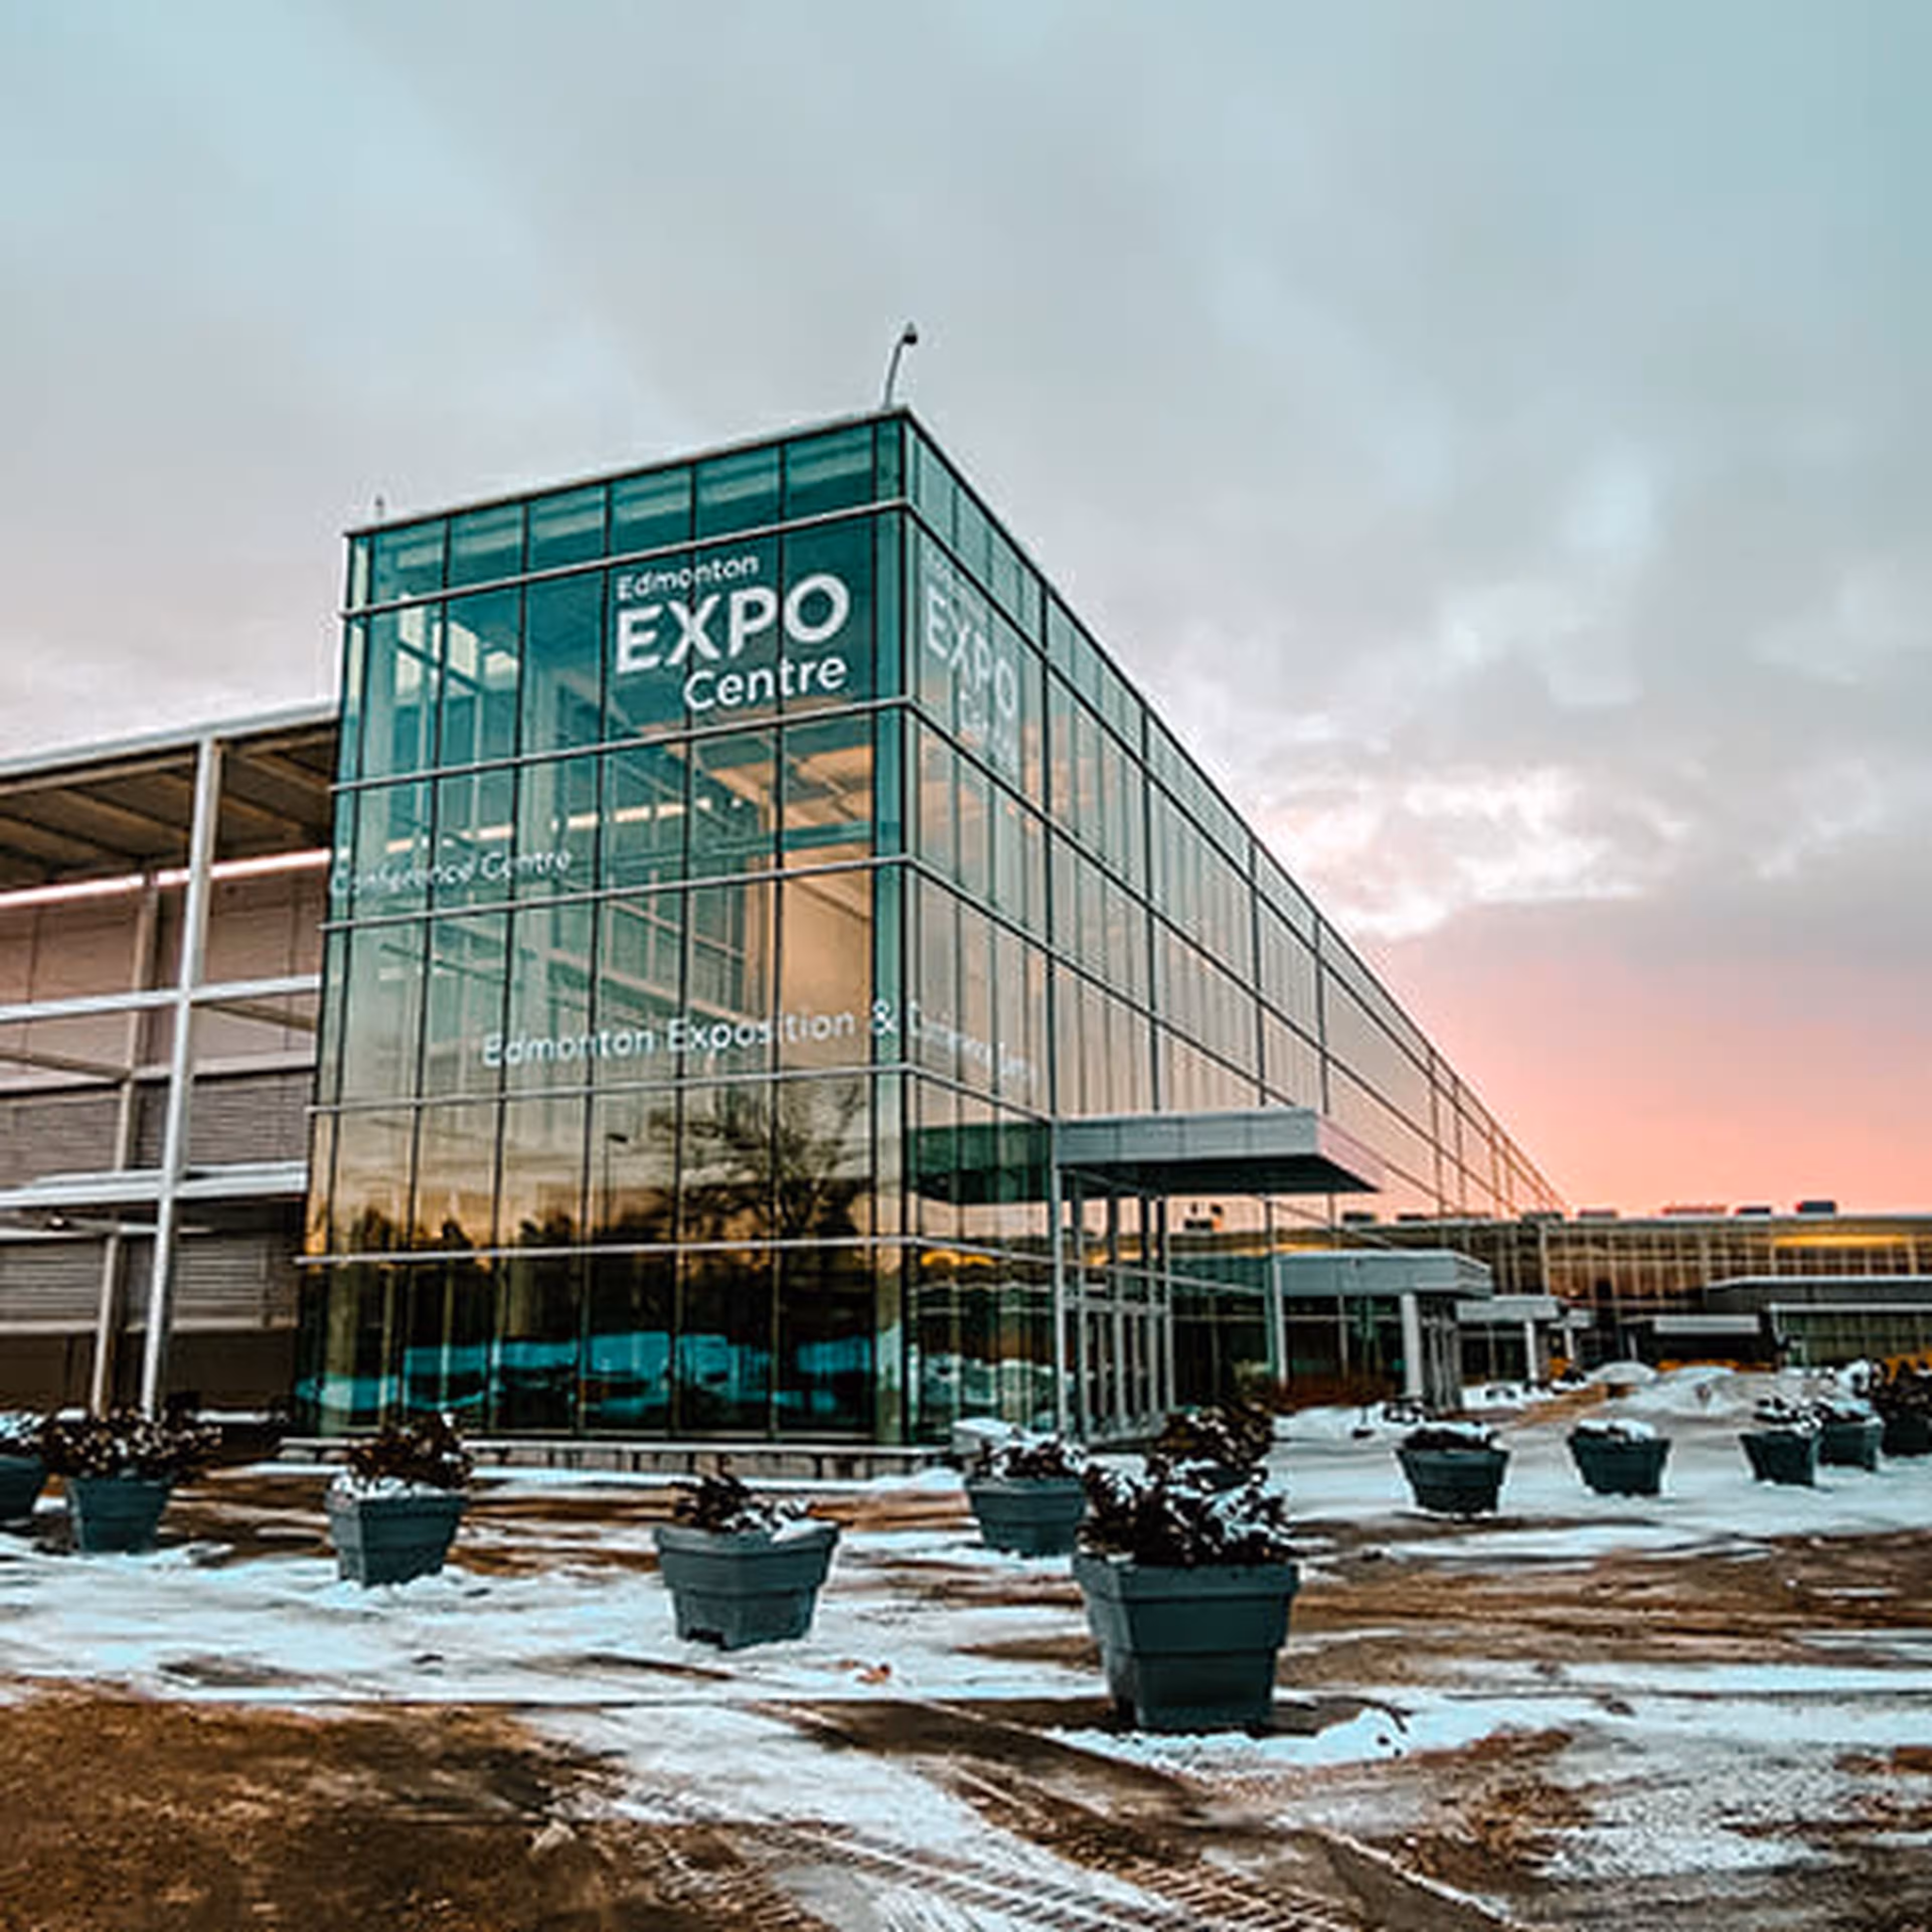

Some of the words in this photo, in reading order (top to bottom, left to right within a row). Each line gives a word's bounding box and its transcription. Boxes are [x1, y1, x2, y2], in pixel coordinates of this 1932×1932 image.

[617, 555, 758, 601] Edmonton
[616, 574, 850, 674] EXPO
[928, 584, 1017, 718] EXPO
[683, 657, 847, 710] Centre
[483, 1029, 655, 1067] Edmonton
[872, 999, 898, 1036] &
